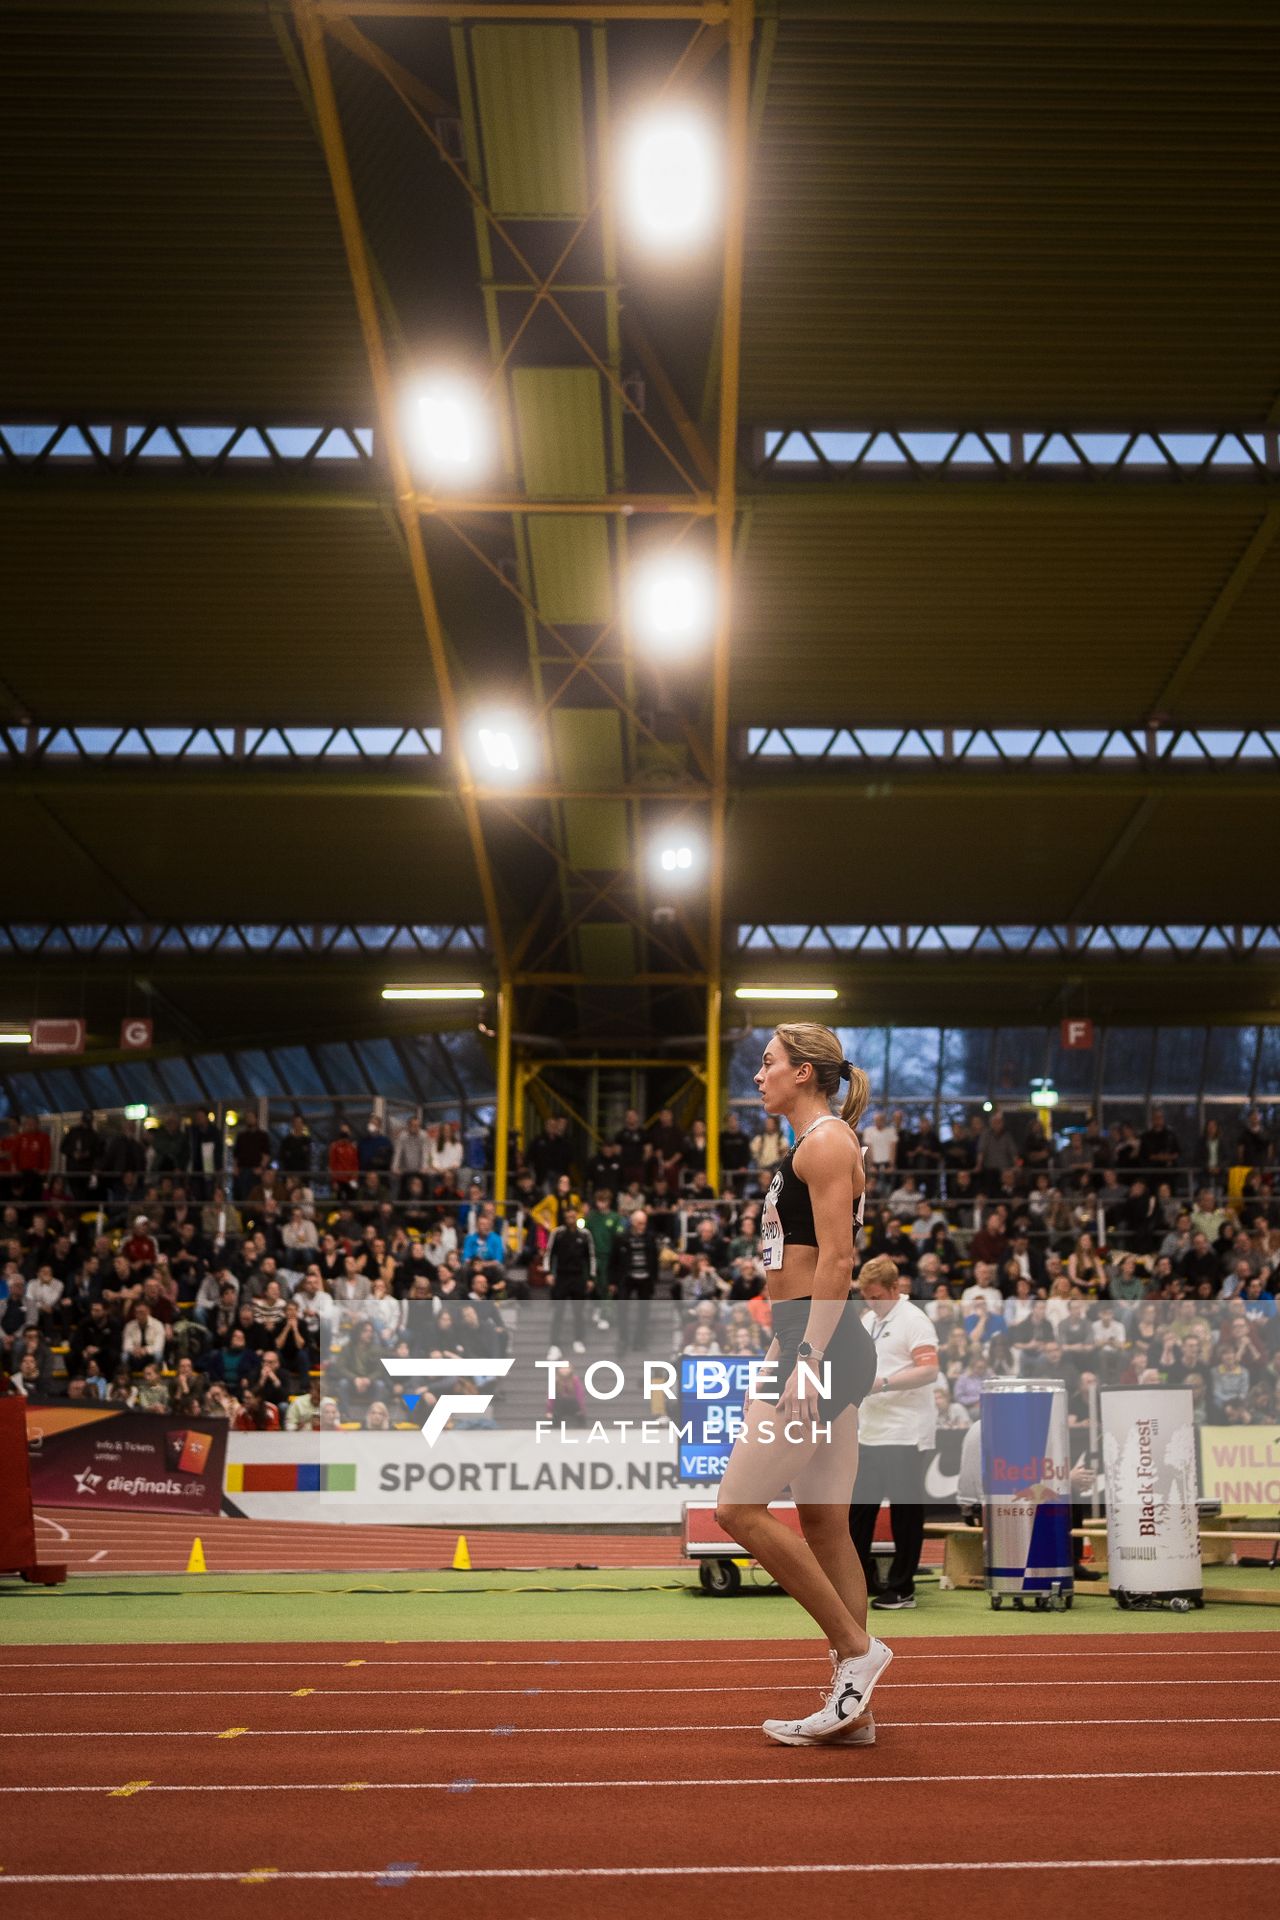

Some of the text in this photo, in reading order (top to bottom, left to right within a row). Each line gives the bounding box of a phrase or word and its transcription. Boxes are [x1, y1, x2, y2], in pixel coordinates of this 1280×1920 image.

[125, 1022, 149, 1045] G
[1067, 1022, 1087, 1045] F
[124, 1441, 155, 1453] Tickets
[380, 1462, 713, 1491] SPORTLAND.NR
[993, 1456, 1038, 1481] Red
[1136, 1418, 1156, 1538] Black Forest
[106, 1475, 206, 1497] diefinals.de
